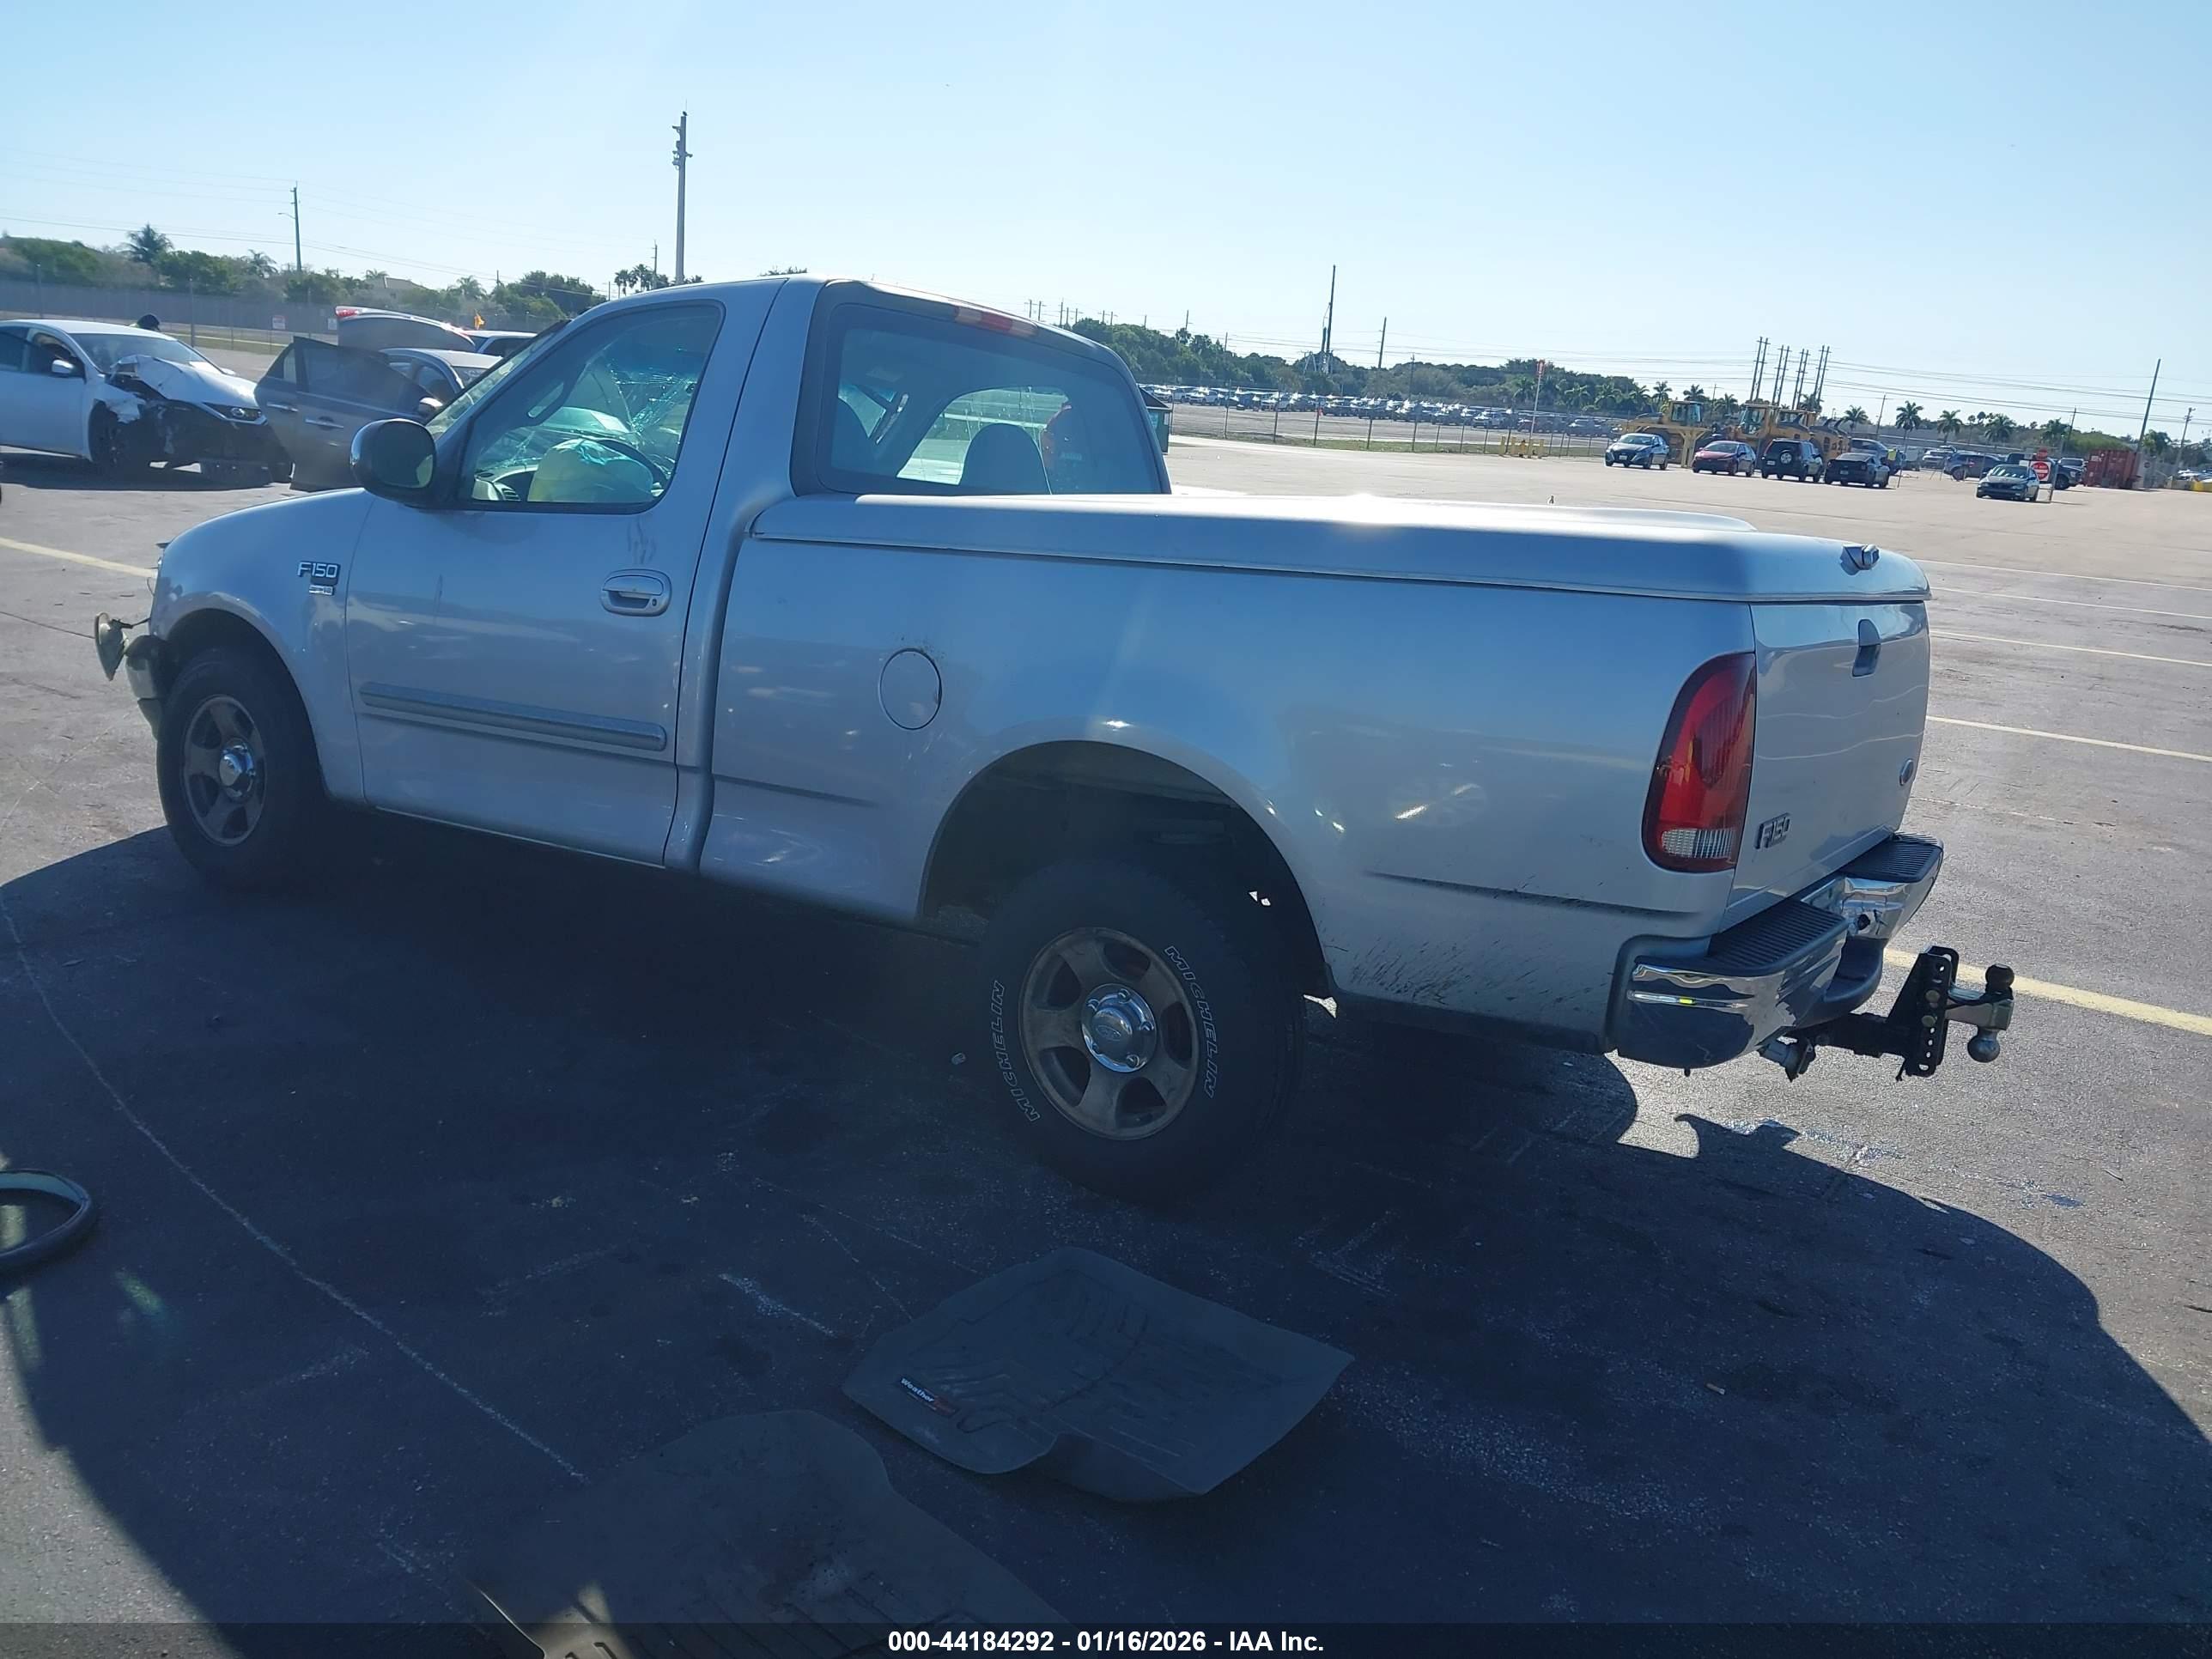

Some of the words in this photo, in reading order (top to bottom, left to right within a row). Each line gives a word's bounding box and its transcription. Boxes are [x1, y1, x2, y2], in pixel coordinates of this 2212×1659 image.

[297, 562, 339, 578] F150
[1755, 814, 1790, 849] F150
[991, 980, 1041, 1121] MICHELIN
[1164, 945, 1218, 1099] MICHELIN
